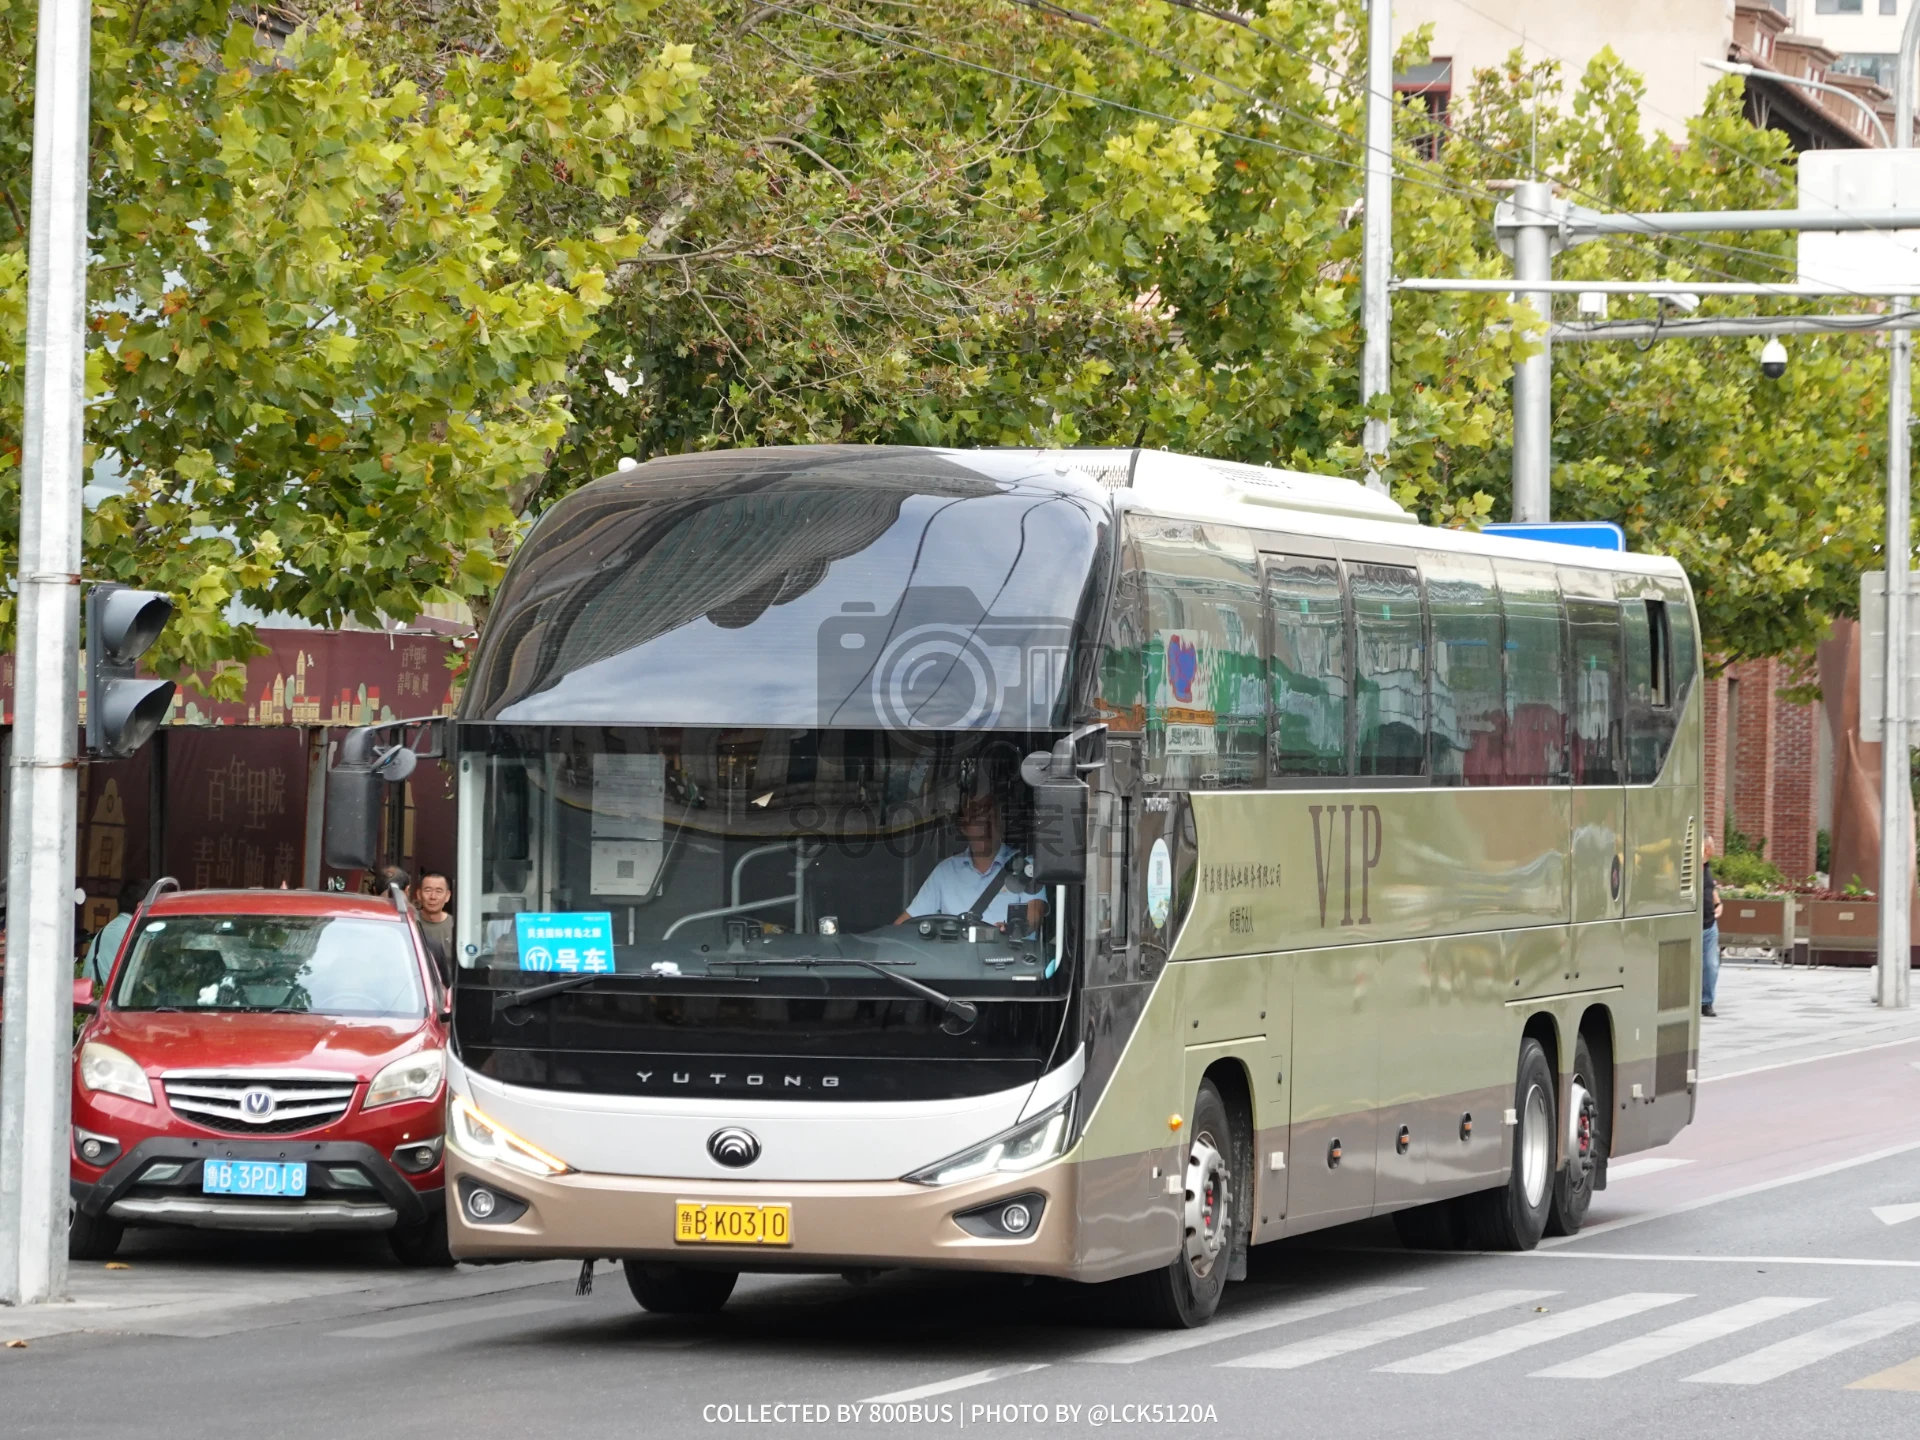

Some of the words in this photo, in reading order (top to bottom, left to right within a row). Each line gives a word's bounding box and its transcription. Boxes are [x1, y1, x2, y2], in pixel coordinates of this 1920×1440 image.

[206, 754, 286, 829] 百年里院
[1308, 804, 1383, 928] VIP
[636, 1071, 840, 1088] YUTONG
